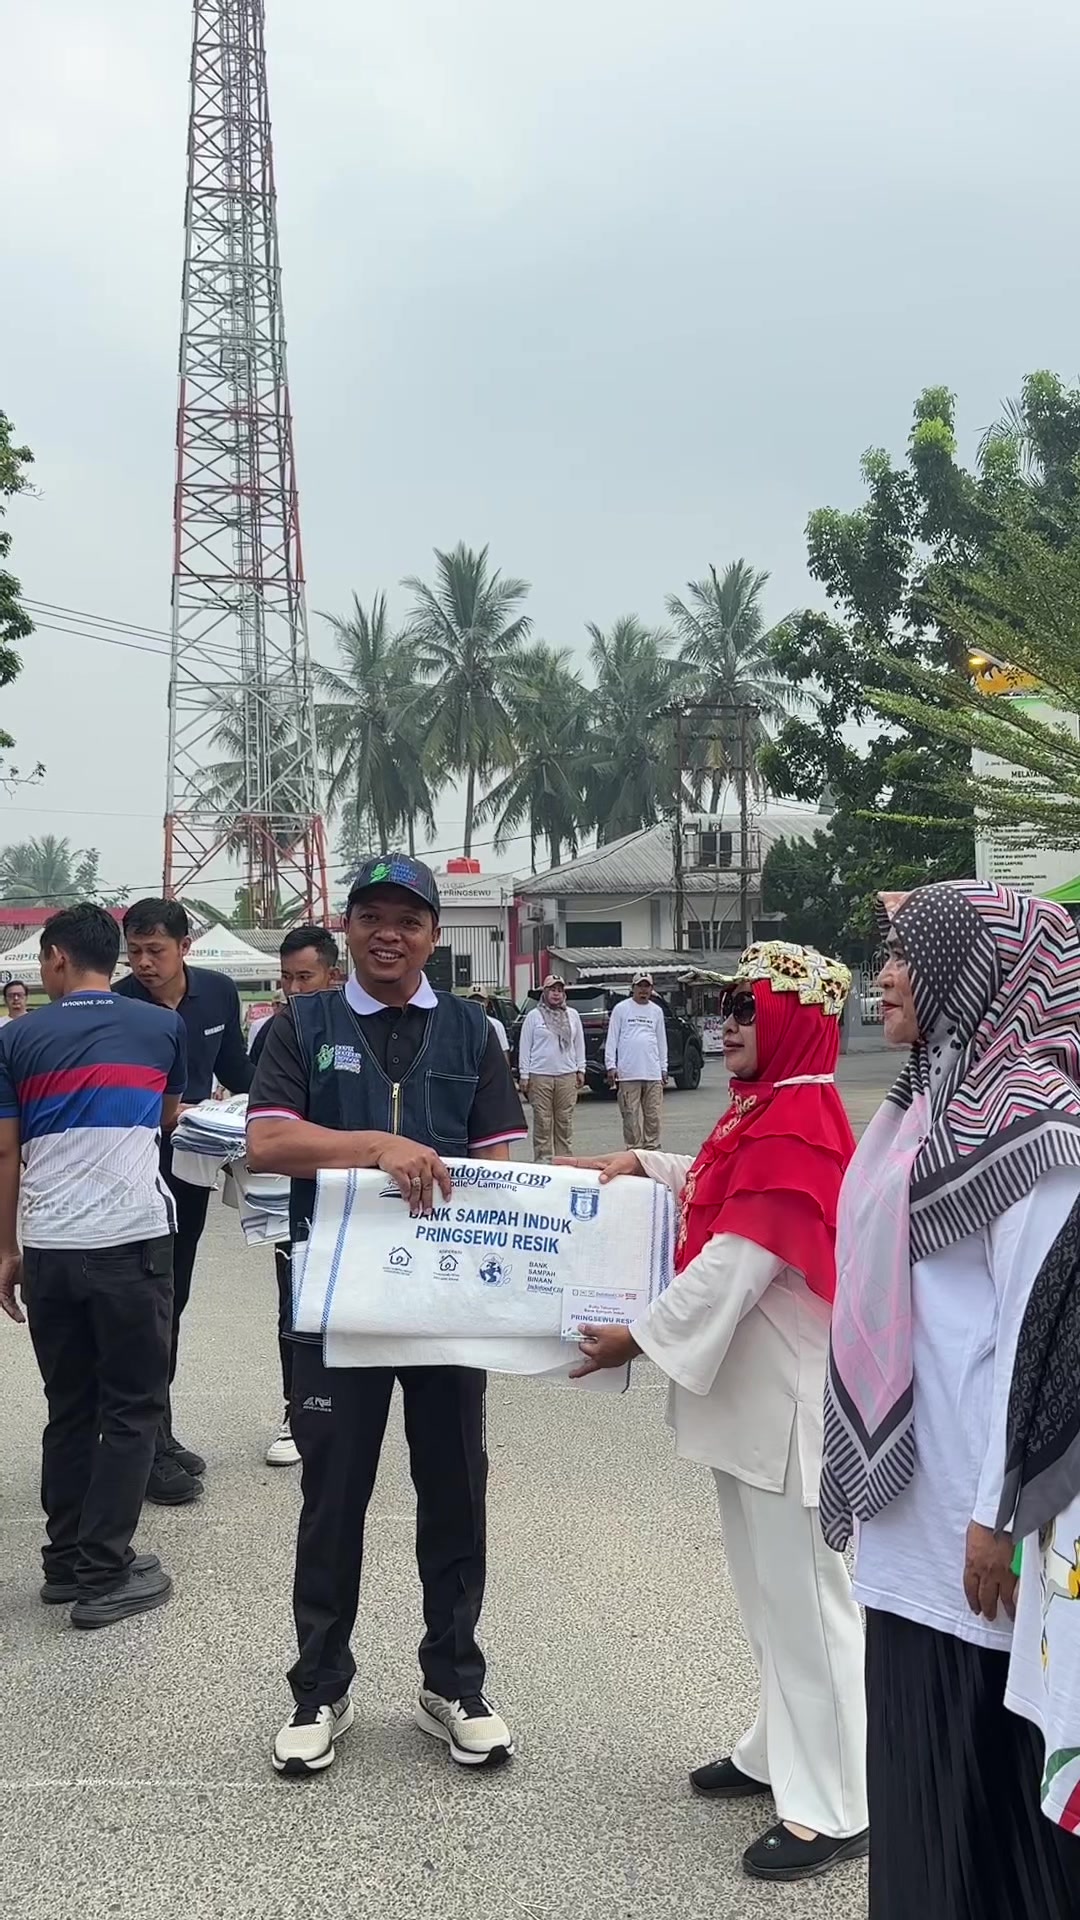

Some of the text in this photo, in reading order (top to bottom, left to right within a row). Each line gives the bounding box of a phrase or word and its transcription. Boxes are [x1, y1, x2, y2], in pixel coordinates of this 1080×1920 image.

[446, 1164, 552, 1188] ndofood CBP
[477, 1181, 518, 1192] Lampung
[455, 1208, 519, 1226] SAMPAH
[523, 1212, 572, 1234] INDUK
[415, 1226, 559, 1254] PRINGSEWU RESIK
[528, 1261, 548, 1270] BANK
[528, 1269, 556, 1277] SAMPAH
[527, 1276, 553, 1285] BINAAN
[570, 1314, 614, 1324] PRINGSEWU
